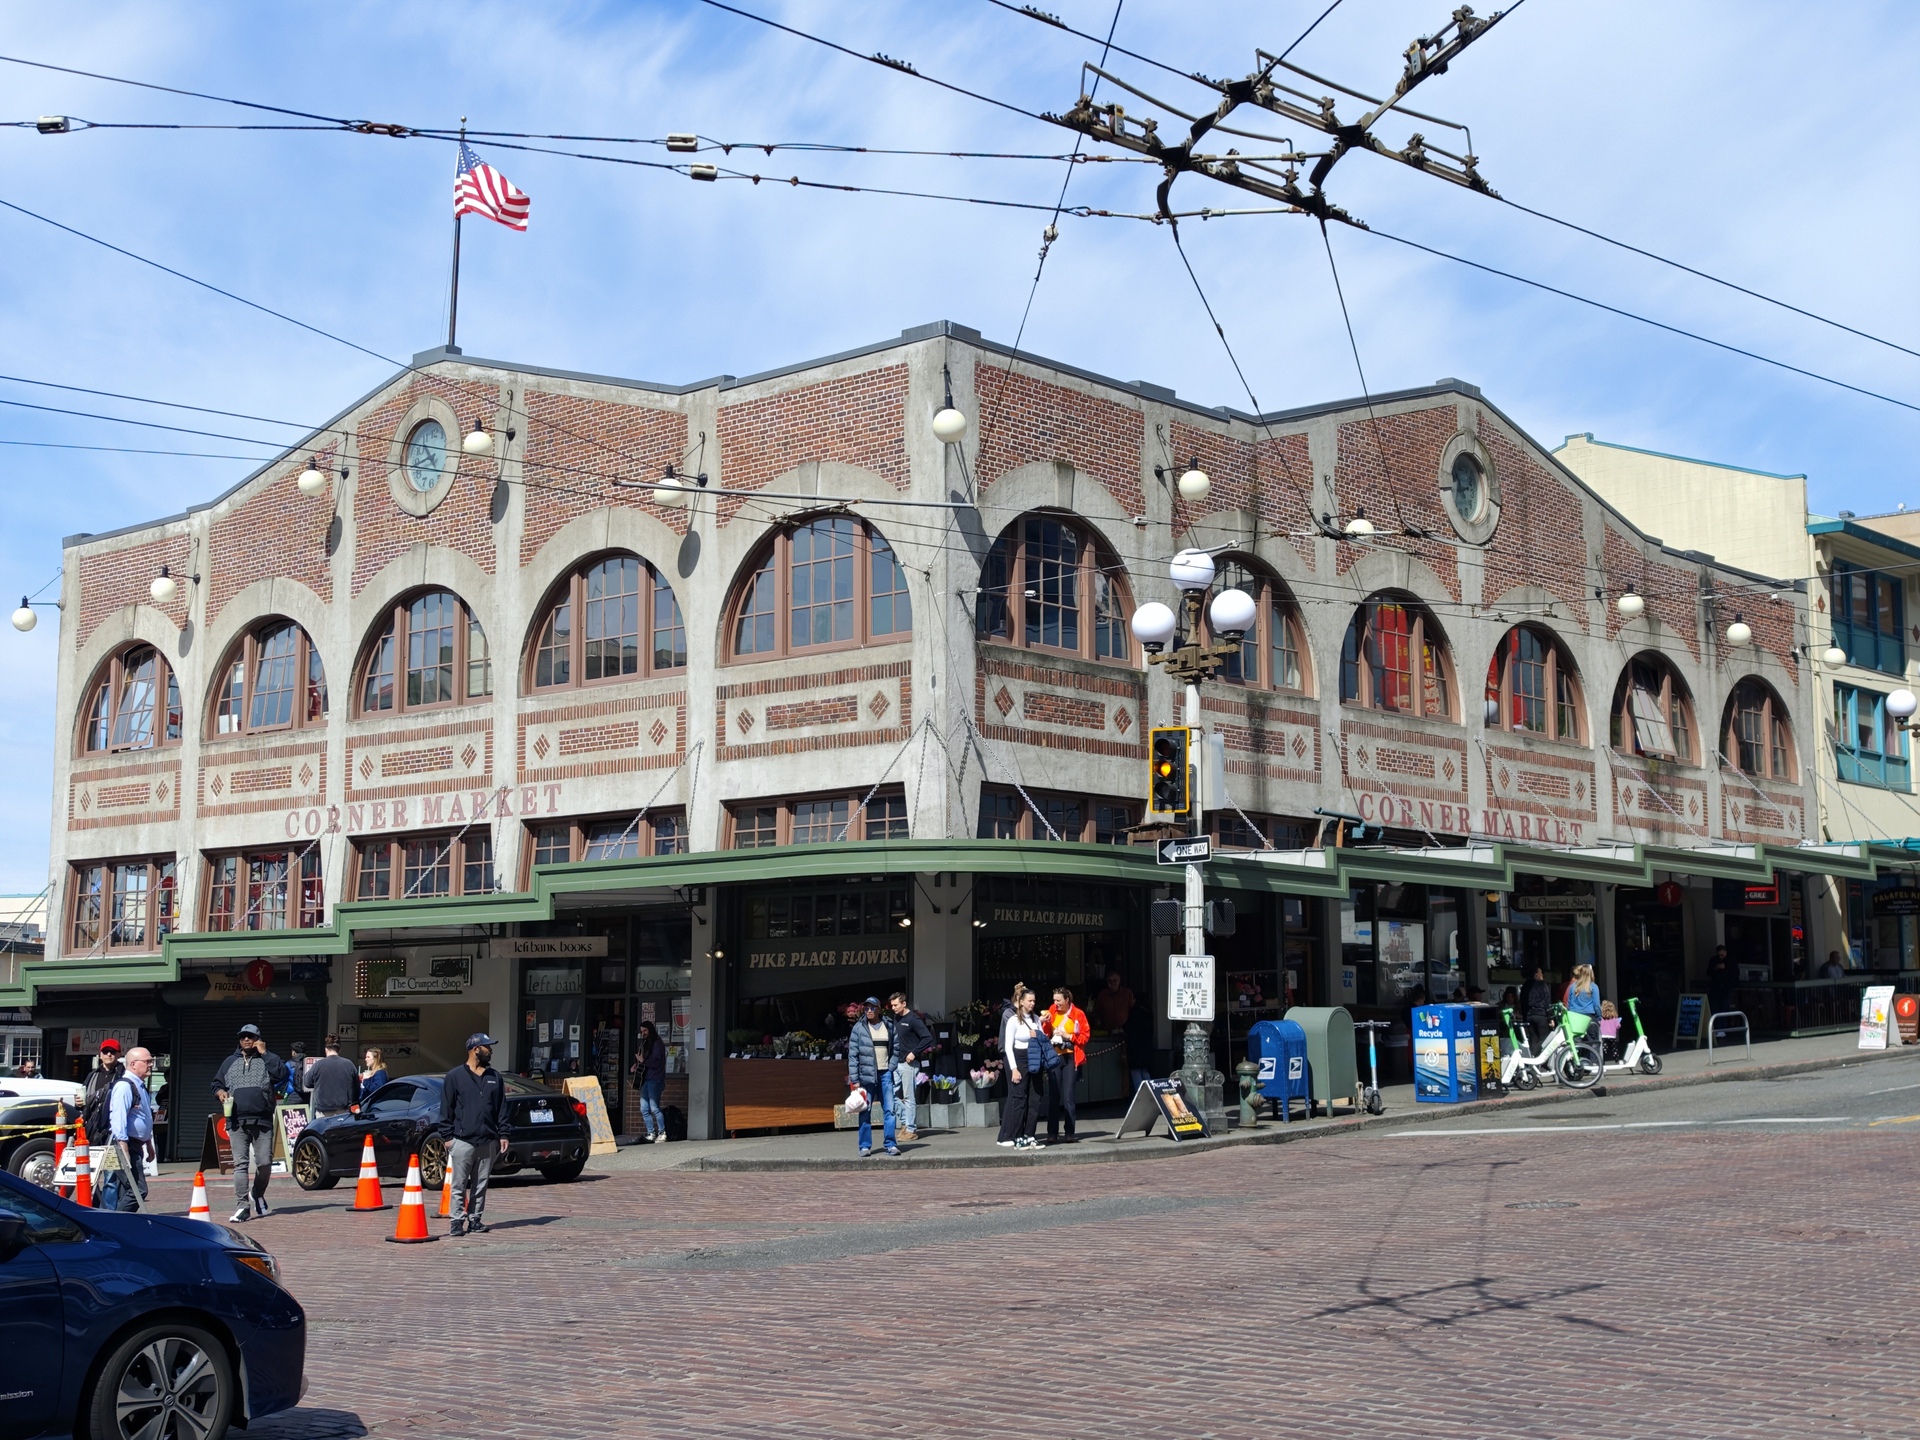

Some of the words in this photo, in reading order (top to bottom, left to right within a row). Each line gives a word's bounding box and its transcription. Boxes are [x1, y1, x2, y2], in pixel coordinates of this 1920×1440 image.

[285, 802, 408, 838] CORNER
[422, 783, 562, 825] MARKET
[1359, 793, 1472, 833] CORNER
[1483, 809, 1583, 846] MARKET
[1176, 845, 1192, 856] ONE
[1193, 843, 1206, 854] WAY
[1523, 897, 1536, 908] The
[1537, 897, 1568, 910] Crumpet
[1570, 897, 1592, 910] Shop
[993, 908, 1020, 922] PIKE
[1022, 909, 1055, 924] PLACE
[1056, 912, 1104, 926] FLOWERS
[559, 941, 592, 952] books
[749, 953, 786, 968] PIKE
[789, 950, 836, 967] PLACE
[841, 948, 907, 965] FLOWERS
[1176, 960, 1191, 969] ALL
[1193, 960, 1209, 969] WAY
[638, 972, 679, 990] books
[1182, 970, 1204, 979] WALK
[215, 982, 241, 991] FROZEN
[391, 978, 406, 989] The
[408, 978, 439, 991] Crumpet
[441, 978, 461, 991] Shop
[528, 974, 550, 992] left
[362, 1011, 384, 1019] MORE
[384, 1011, 407, 1019] SHOPS
[83, 1029, 109, 1044] ADITI
[111, 1029, 136, 1044] CHAI
[1418, 1030, 1443, 1038] Recycle
[1457, 1030, 1472, 1038] Recycle
[1481, 1029, 1497, 1037] Garbage
[286, 1109, 300, 1118] The
[283, 1113, 308, 1128] Crumpet
